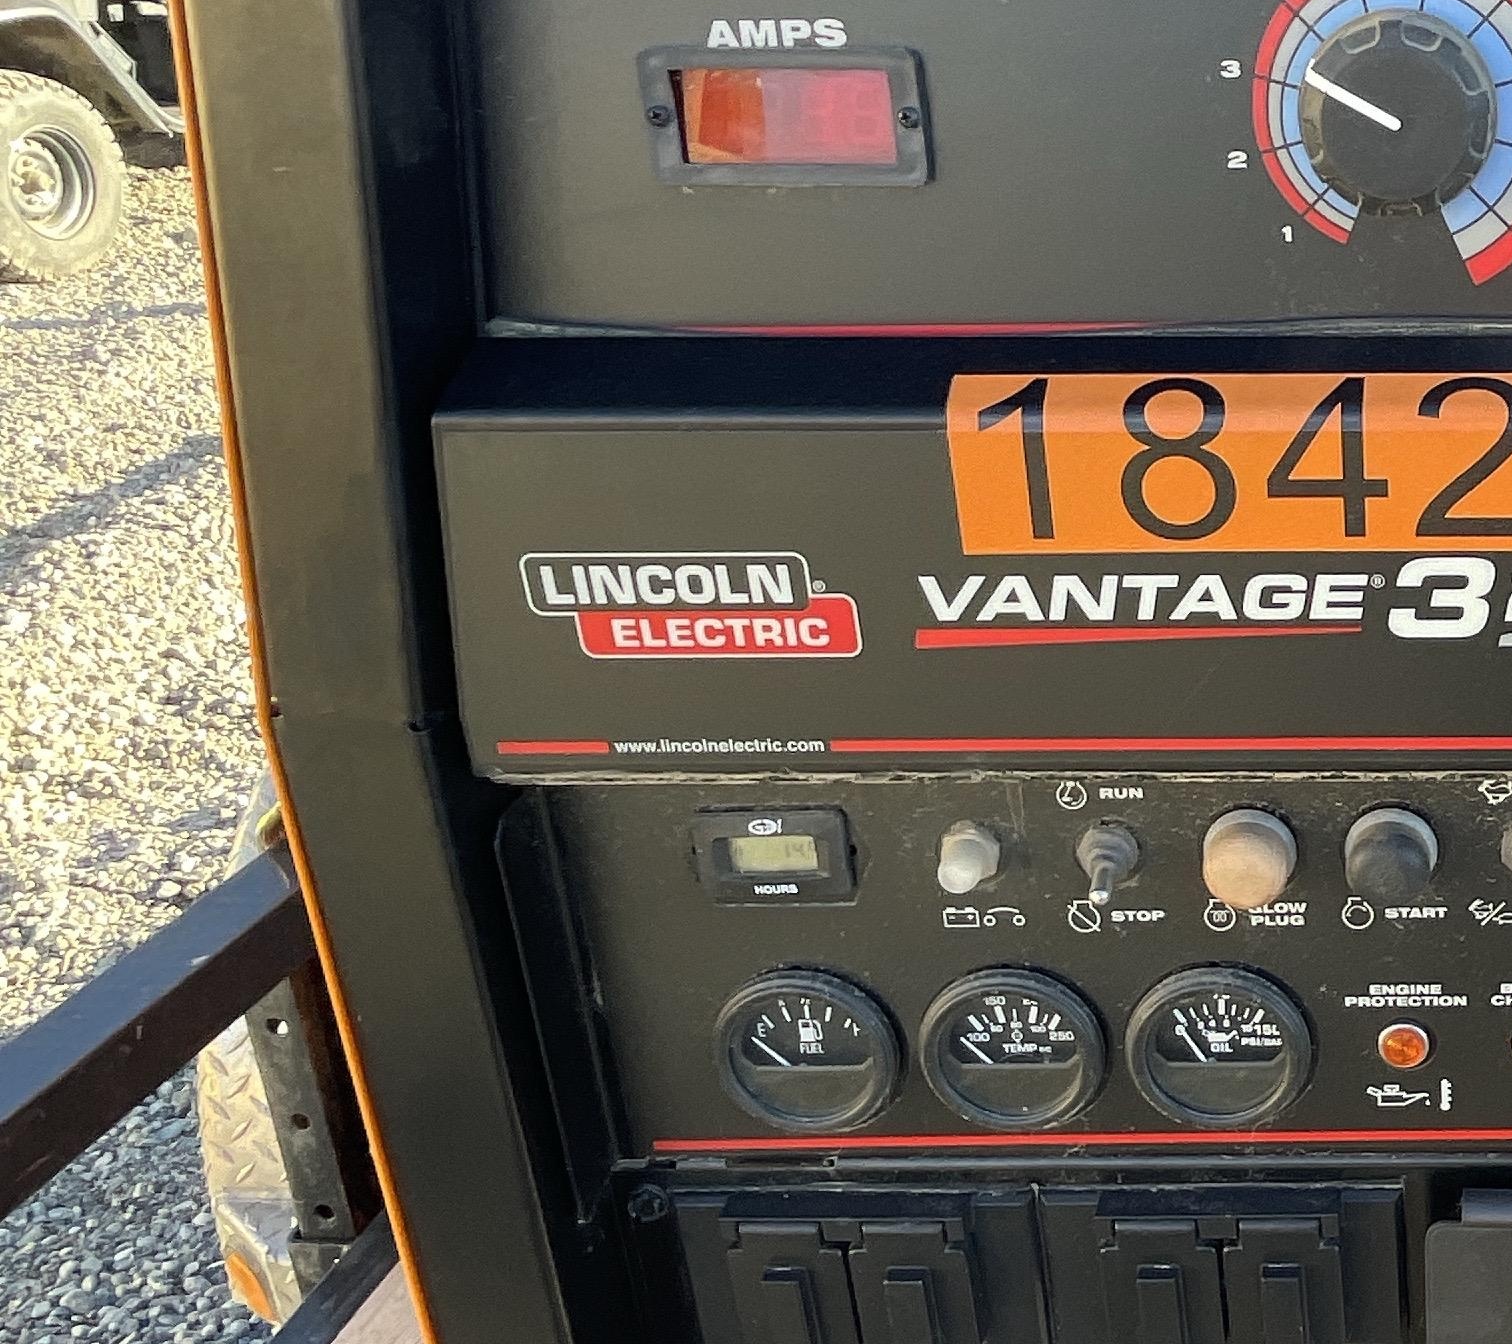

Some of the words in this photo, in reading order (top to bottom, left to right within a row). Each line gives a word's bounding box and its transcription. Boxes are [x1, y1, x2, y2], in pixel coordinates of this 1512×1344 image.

[706, 18, 848, 49] AMPS
[1220, 60, 1241, 79] 3
[1227, 150, 1248, 170] 2
[1281, 225, 1293, 243] 1
[540, 563, 794, 607] LINCOLN
[610, 617, 831, 649] ELECTRIC
[612, 737, 826, 754] www.lincolnelectric.com
[1099, 787, 1144, 800] RUN
[753, 884, 799, 895] HOURS
[1110, 910, 1166, 923] STOP
[1384, 906, 1448, 920] START
[1250, 914, 1306, 927] PLUG
[1368, 984, 1443, 995] ENGINE
[1344, 995, 1468, 1007] PROTECTION
[757, 1022, 767, 1037] E
[799, 1042, 825, 1054] FUEL
[1002, 1043, 1038, 1054] TEMP
[1210, 1042, 1234, 1053] OIL
